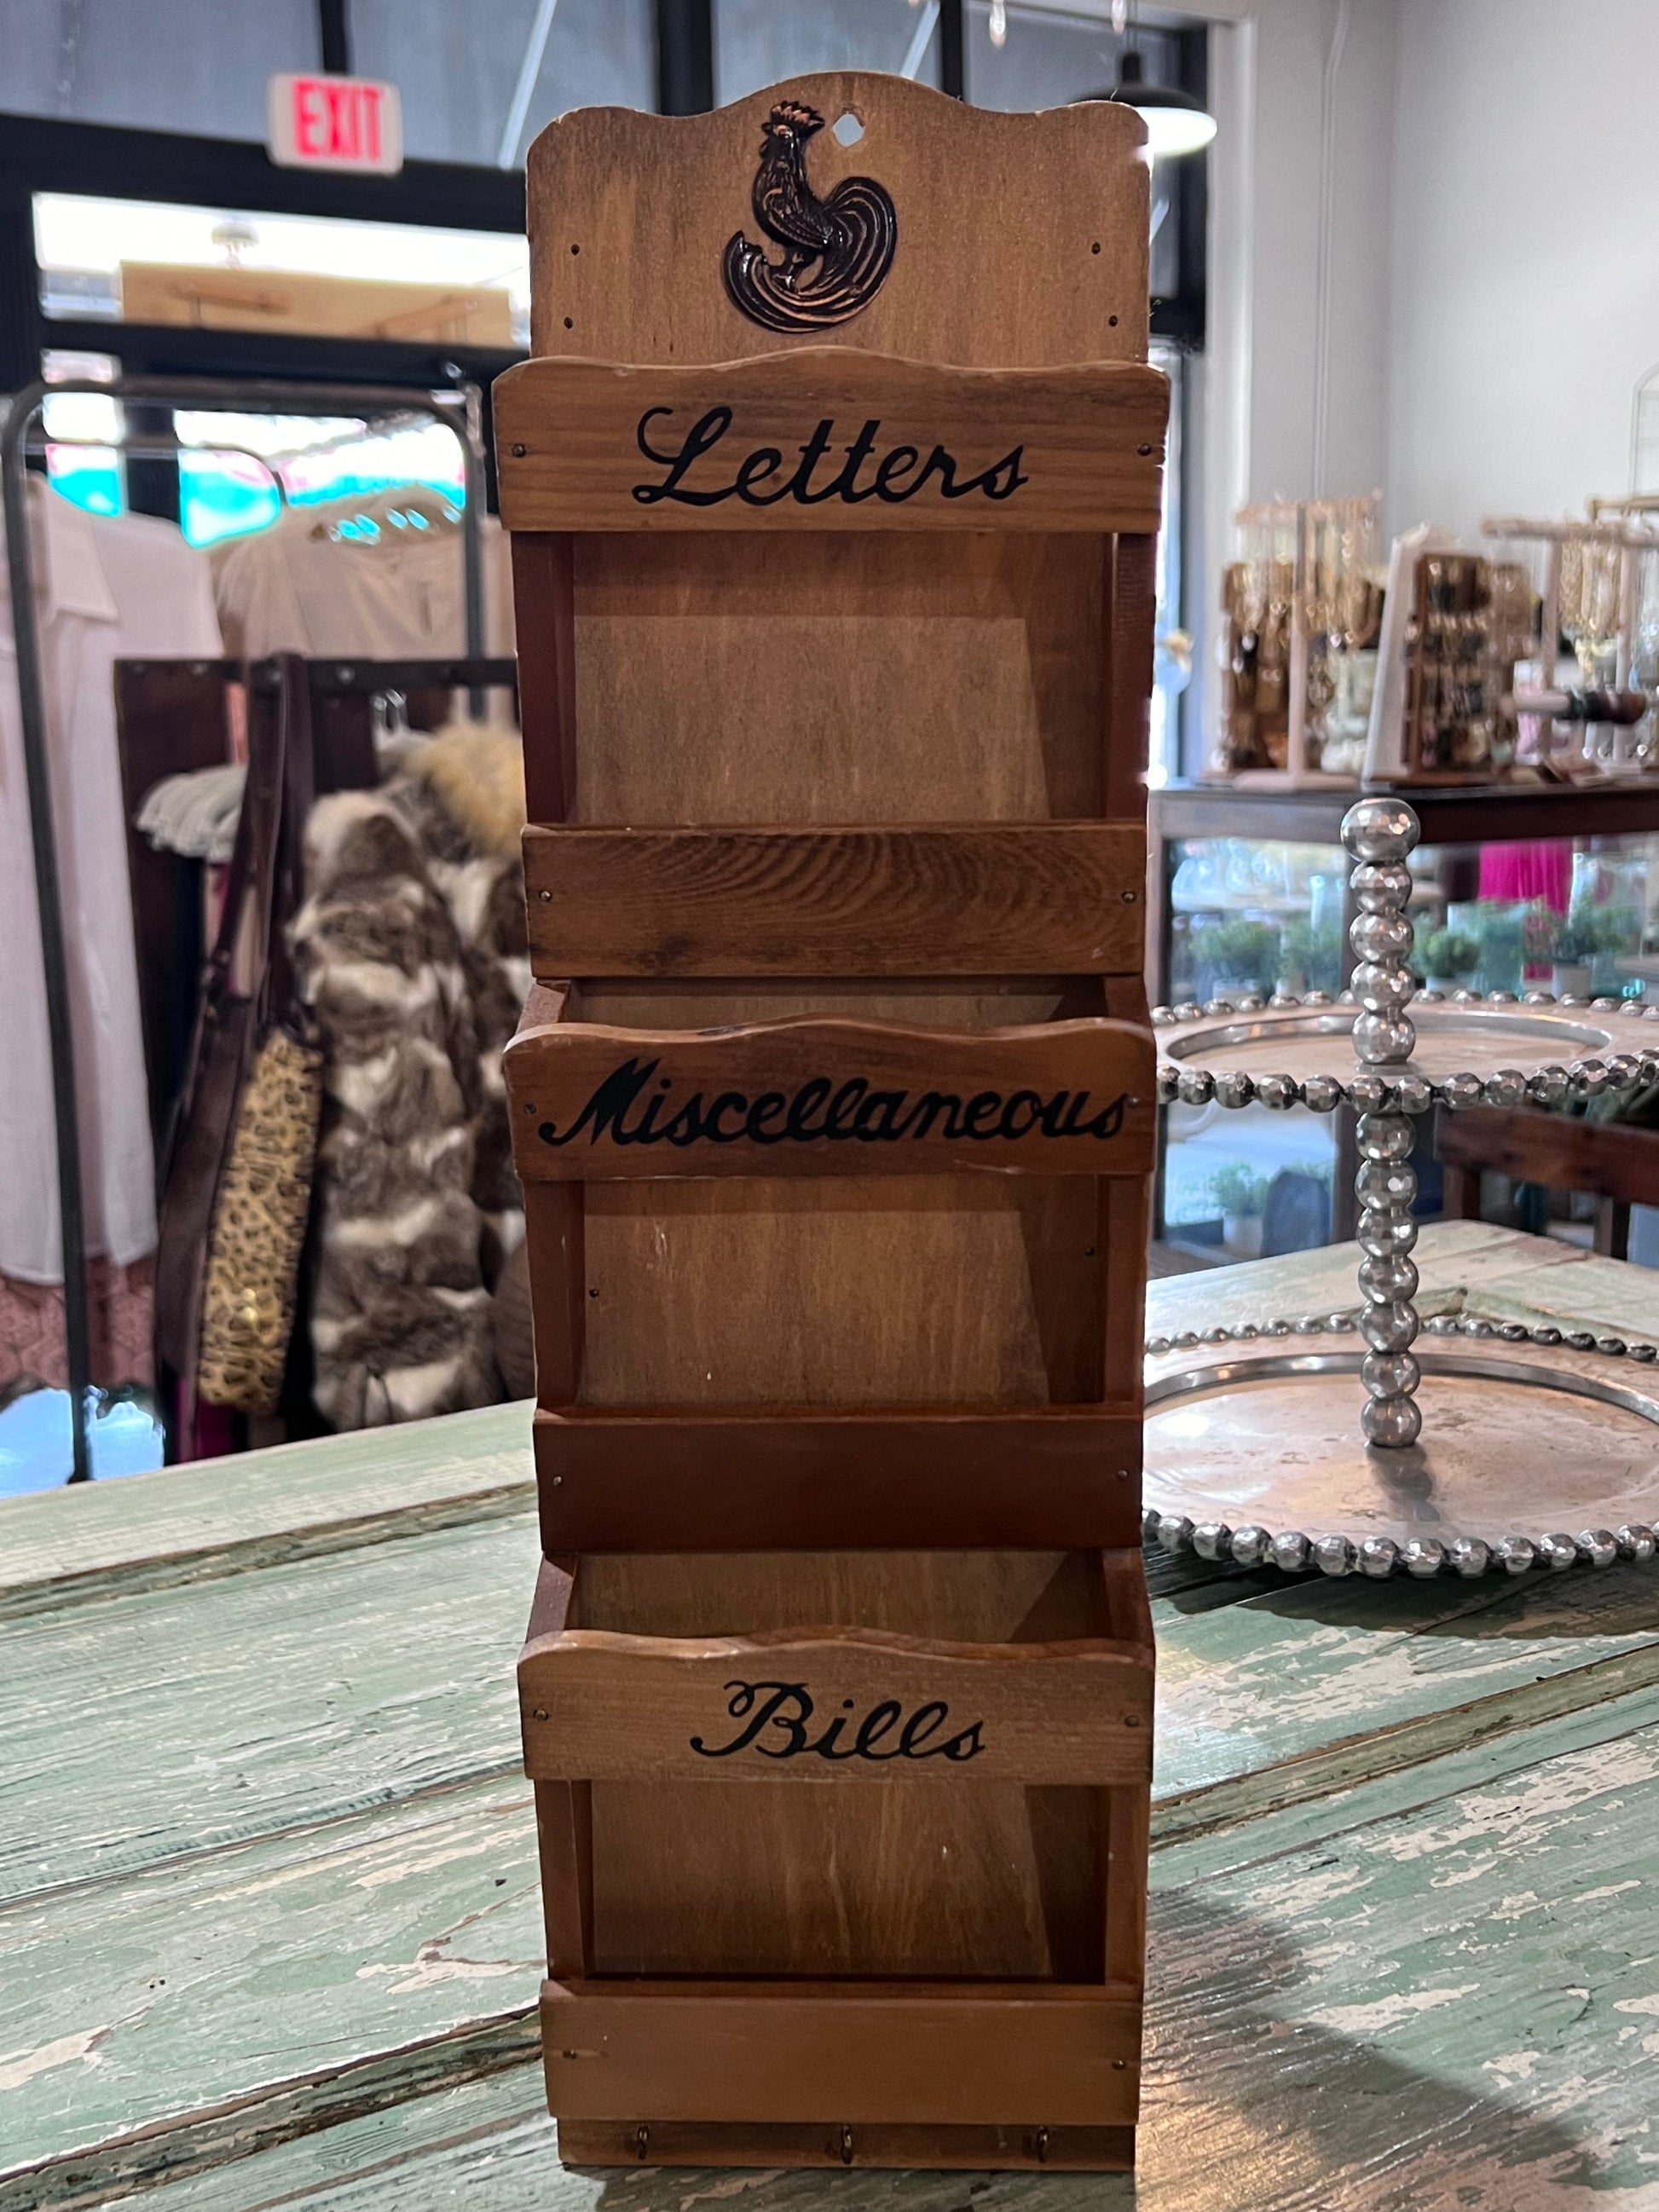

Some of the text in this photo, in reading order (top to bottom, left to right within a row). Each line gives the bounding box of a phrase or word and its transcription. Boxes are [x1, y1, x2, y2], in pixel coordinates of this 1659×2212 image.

[293, 78, 383, 161] EXIT
[632, 407, 1029, 506] Letters
[540, 1056, 1130, 1146] Miscellaneous
[690, 1680, 986, 1760] Bills
